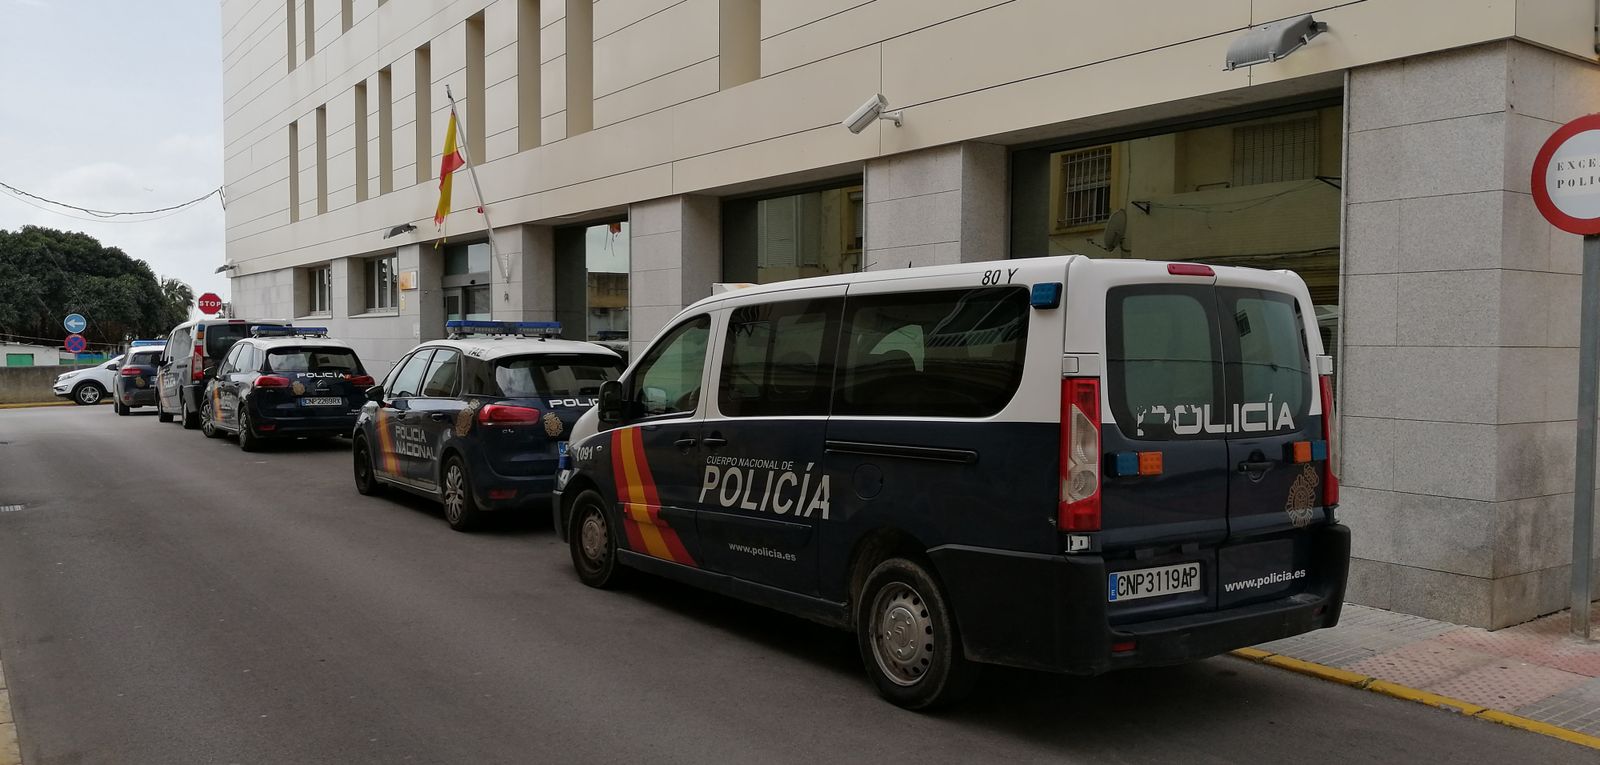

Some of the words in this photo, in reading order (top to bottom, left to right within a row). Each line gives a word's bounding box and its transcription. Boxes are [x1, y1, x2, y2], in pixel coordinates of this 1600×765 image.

[1556, 158, 1600, 171] EXCE
[1557, 175, 1600, 188] POLI
[981, 269, 1001, 285] 80
[1007, 268, 1018, 284] Y
[549, 398, 599, 408] POLIC
[395, 440, 437, 460] NACIONAL
[706, 455, 738, 467] CUERPO
[738, 457, 780, 470] NACIONAL
[781, 460, 794, 471] DE
[698, 462, 830, 520] POLICÍA
[728, 543, 797, 562] www.policia.es
[1117, 566, 1198, 596] CNP3119AP
[1224, 567, 1306, 593] www.policia.es
